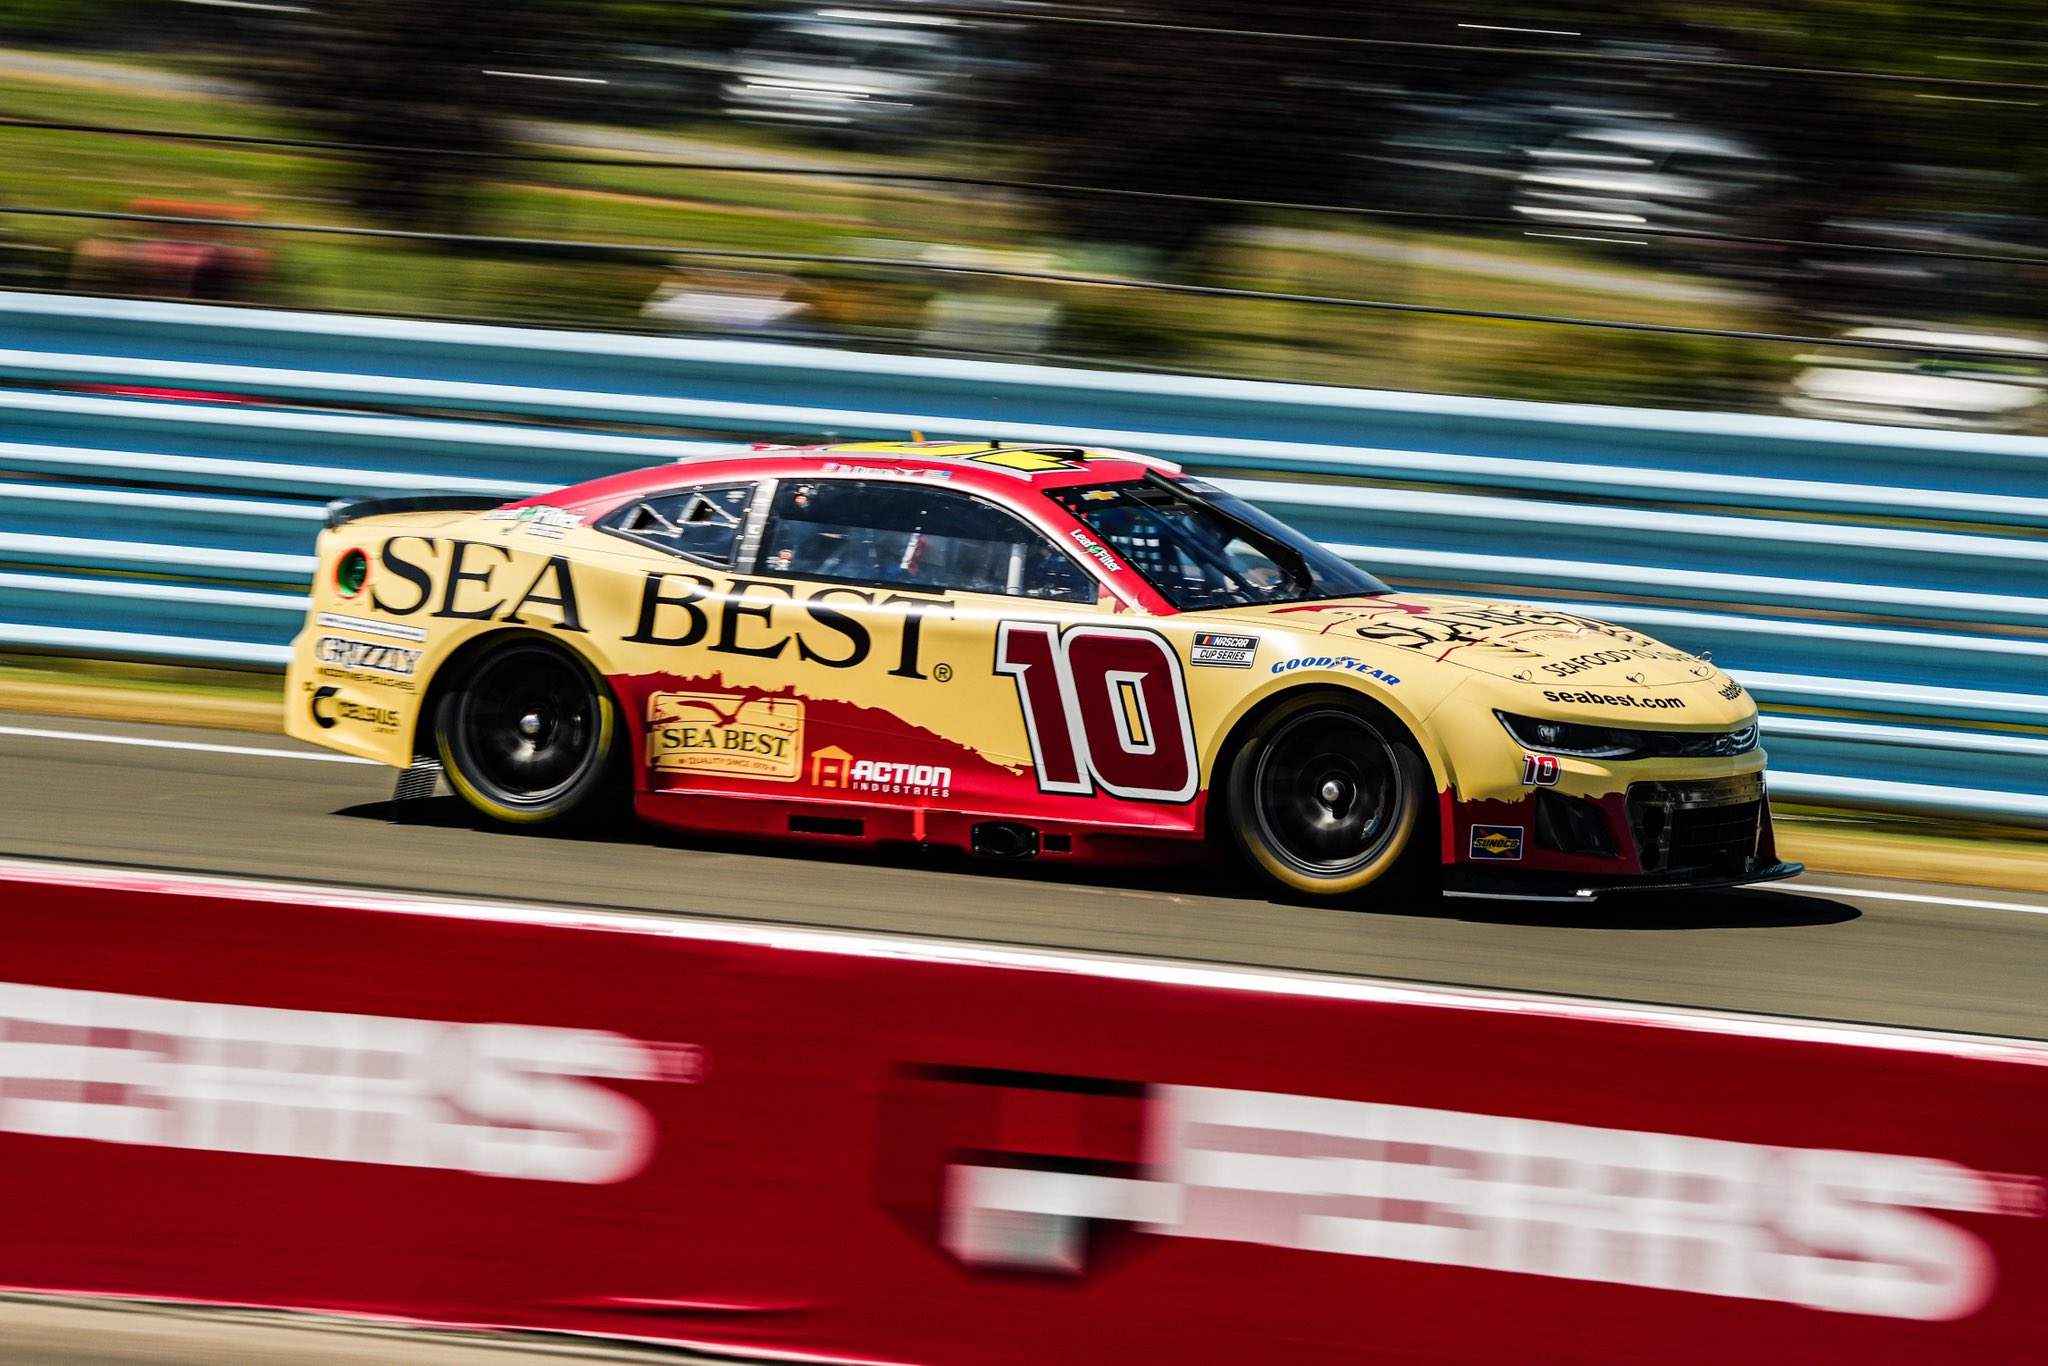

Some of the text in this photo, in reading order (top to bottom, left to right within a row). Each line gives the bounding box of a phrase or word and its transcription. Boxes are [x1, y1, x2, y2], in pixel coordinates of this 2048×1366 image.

[370, 535, 590, 633] SEA
[1199, 649, 1247, 661] CUP SERIES
[1213, 636, 1250, 648] NASCAR
[1271, 656, 1401, 687] GOODYEAR
[1541, 650, 1631, 678] SEAFOOD
[992, 619, 1200, 806] 10
[1543, 690, 1686, 709] seabest.com
[662, 727, 791, 759] SEA BEST
[850, 760, 952, 788] ACTION
[1522, 754, 1561, 787] 10
[852, 781, 950, 798] INDUSTRIES
[1473, 837, 1520, 849] SUNOCO
